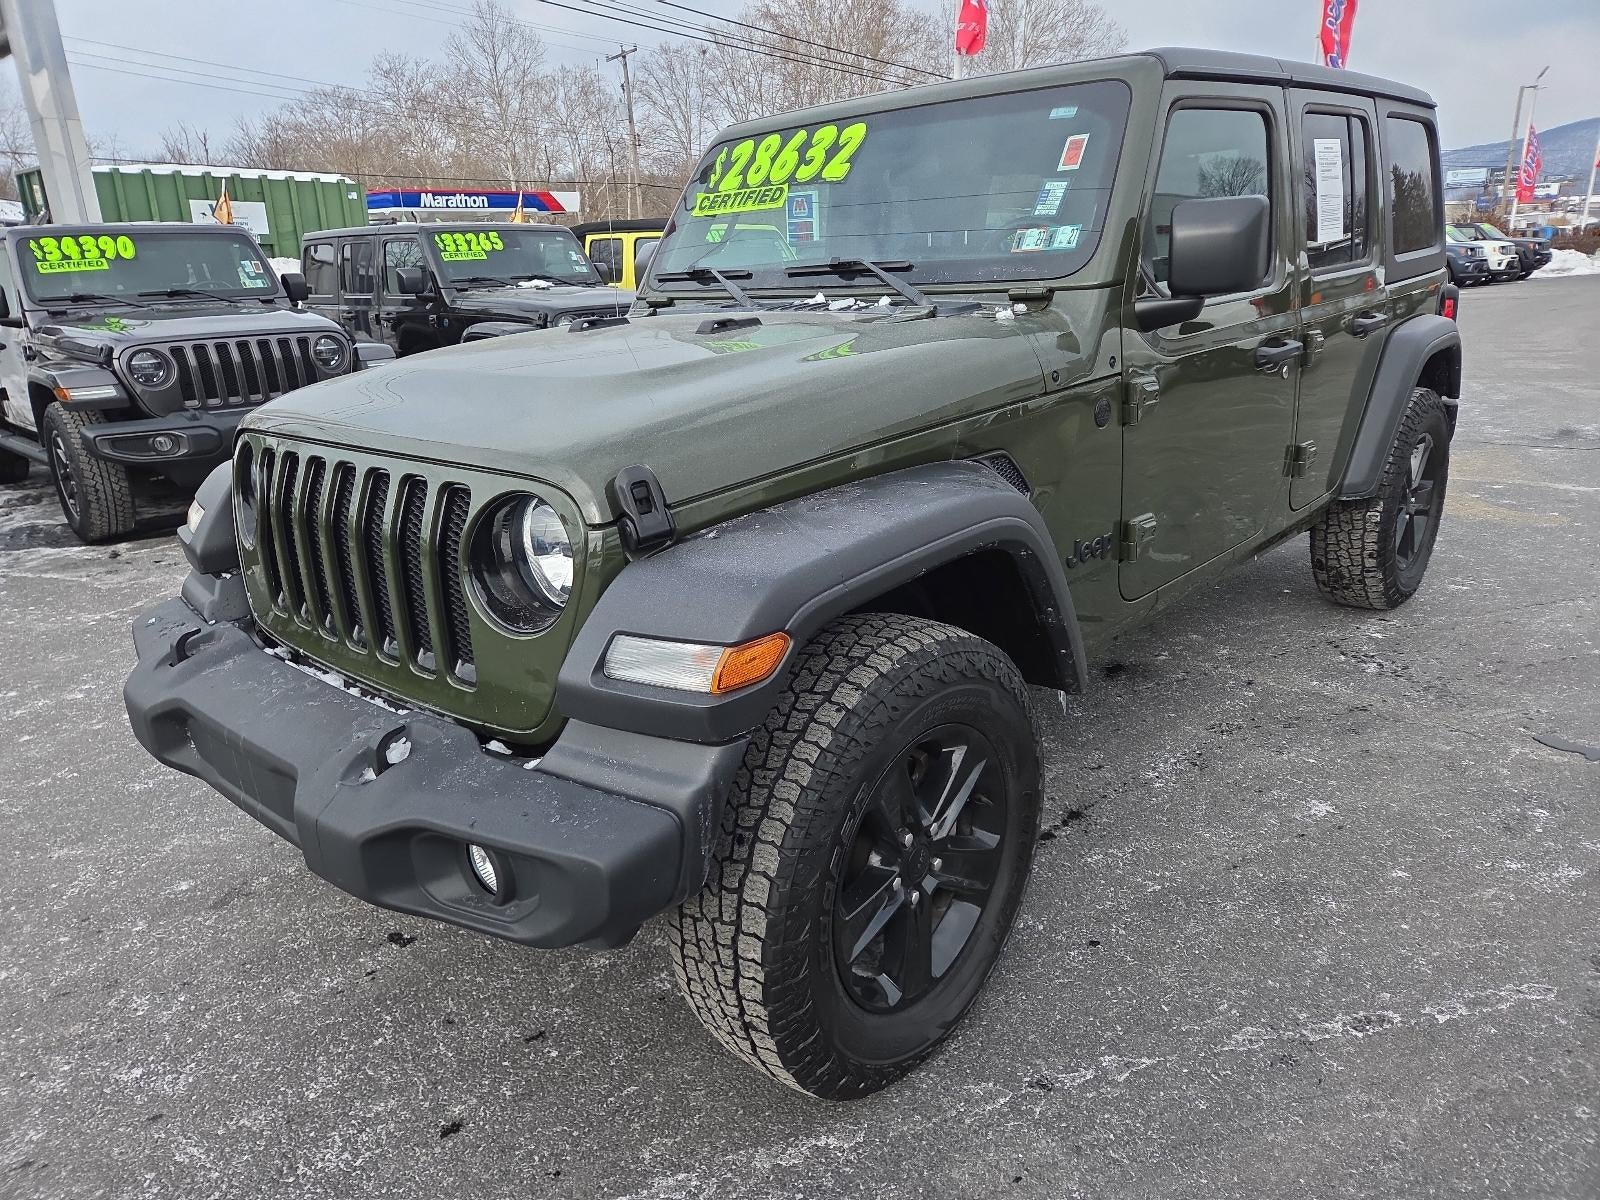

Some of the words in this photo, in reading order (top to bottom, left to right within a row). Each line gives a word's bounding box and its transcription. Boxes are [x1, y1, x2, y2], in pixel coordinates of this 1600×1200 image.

[709, 122, 867, 192] $28632
[420, 192, 489, 208] Marathon
[698, 187, 786, 212] CERTIFIED
[29, 235, 136, 261] $34390
[434, 231, 504, 252] $33265
[40, 260, 104, 271] CERTIFIED
[443, 251, 485, 259] CERTIFIED
[1065, 532, 1112, 569] Jeep
